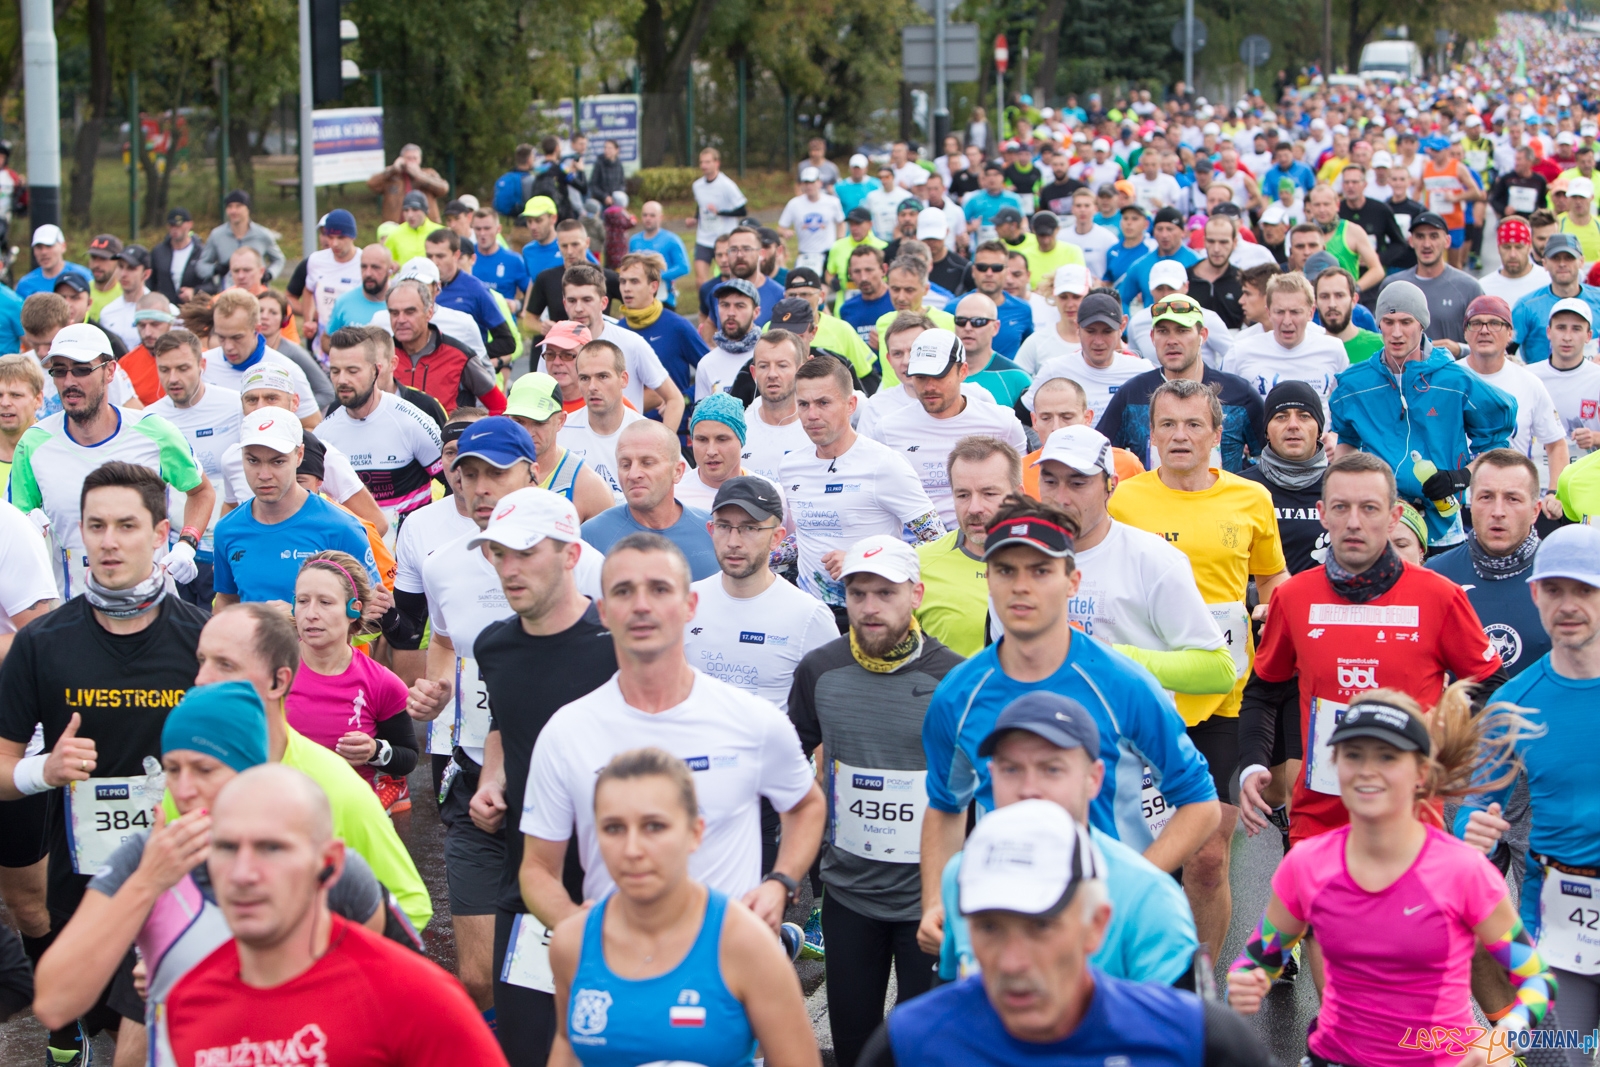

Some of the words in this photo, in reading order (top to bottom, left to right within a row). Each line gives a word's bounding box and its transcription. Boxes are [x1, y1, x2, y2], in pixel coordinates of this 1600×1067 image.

[350, 452, 372, 460] TORUŃ
[922, 462, 944, 471] SIŁA
[797, 500, 814, 509] SIŁA
[800, 510, 839, 518] ODWAGA
[797, 519, 841, 527] SZYBKOŚĆ
[231, 550, 246, 562] 4F
[1350, 606, 1383, 623] FESTIWAL
[1385, 607, 1417, 625] BIEGOWY
[691, 627, 703, 636] 4F
[1307, 628, 1325, 639] 4F
[742, 634, 764, 642] 17.PKO
[701, 650, 724, 661] SIŁA
[706, 662, 759, 676] ODWAGA
[1337, 666, 1379, 689] bbl
[854, 778, 882, 788] 17.PKO
[98, 788, 128, 797] 17.PKO
[849, 799, 914, 822] 4366
[95, 808, 155, 832] 384
[863, 824, 896, 835] Marcin
[1563, 883, 1592, 896] 17.PKO
[1568, 907, 1600, 931] 42
